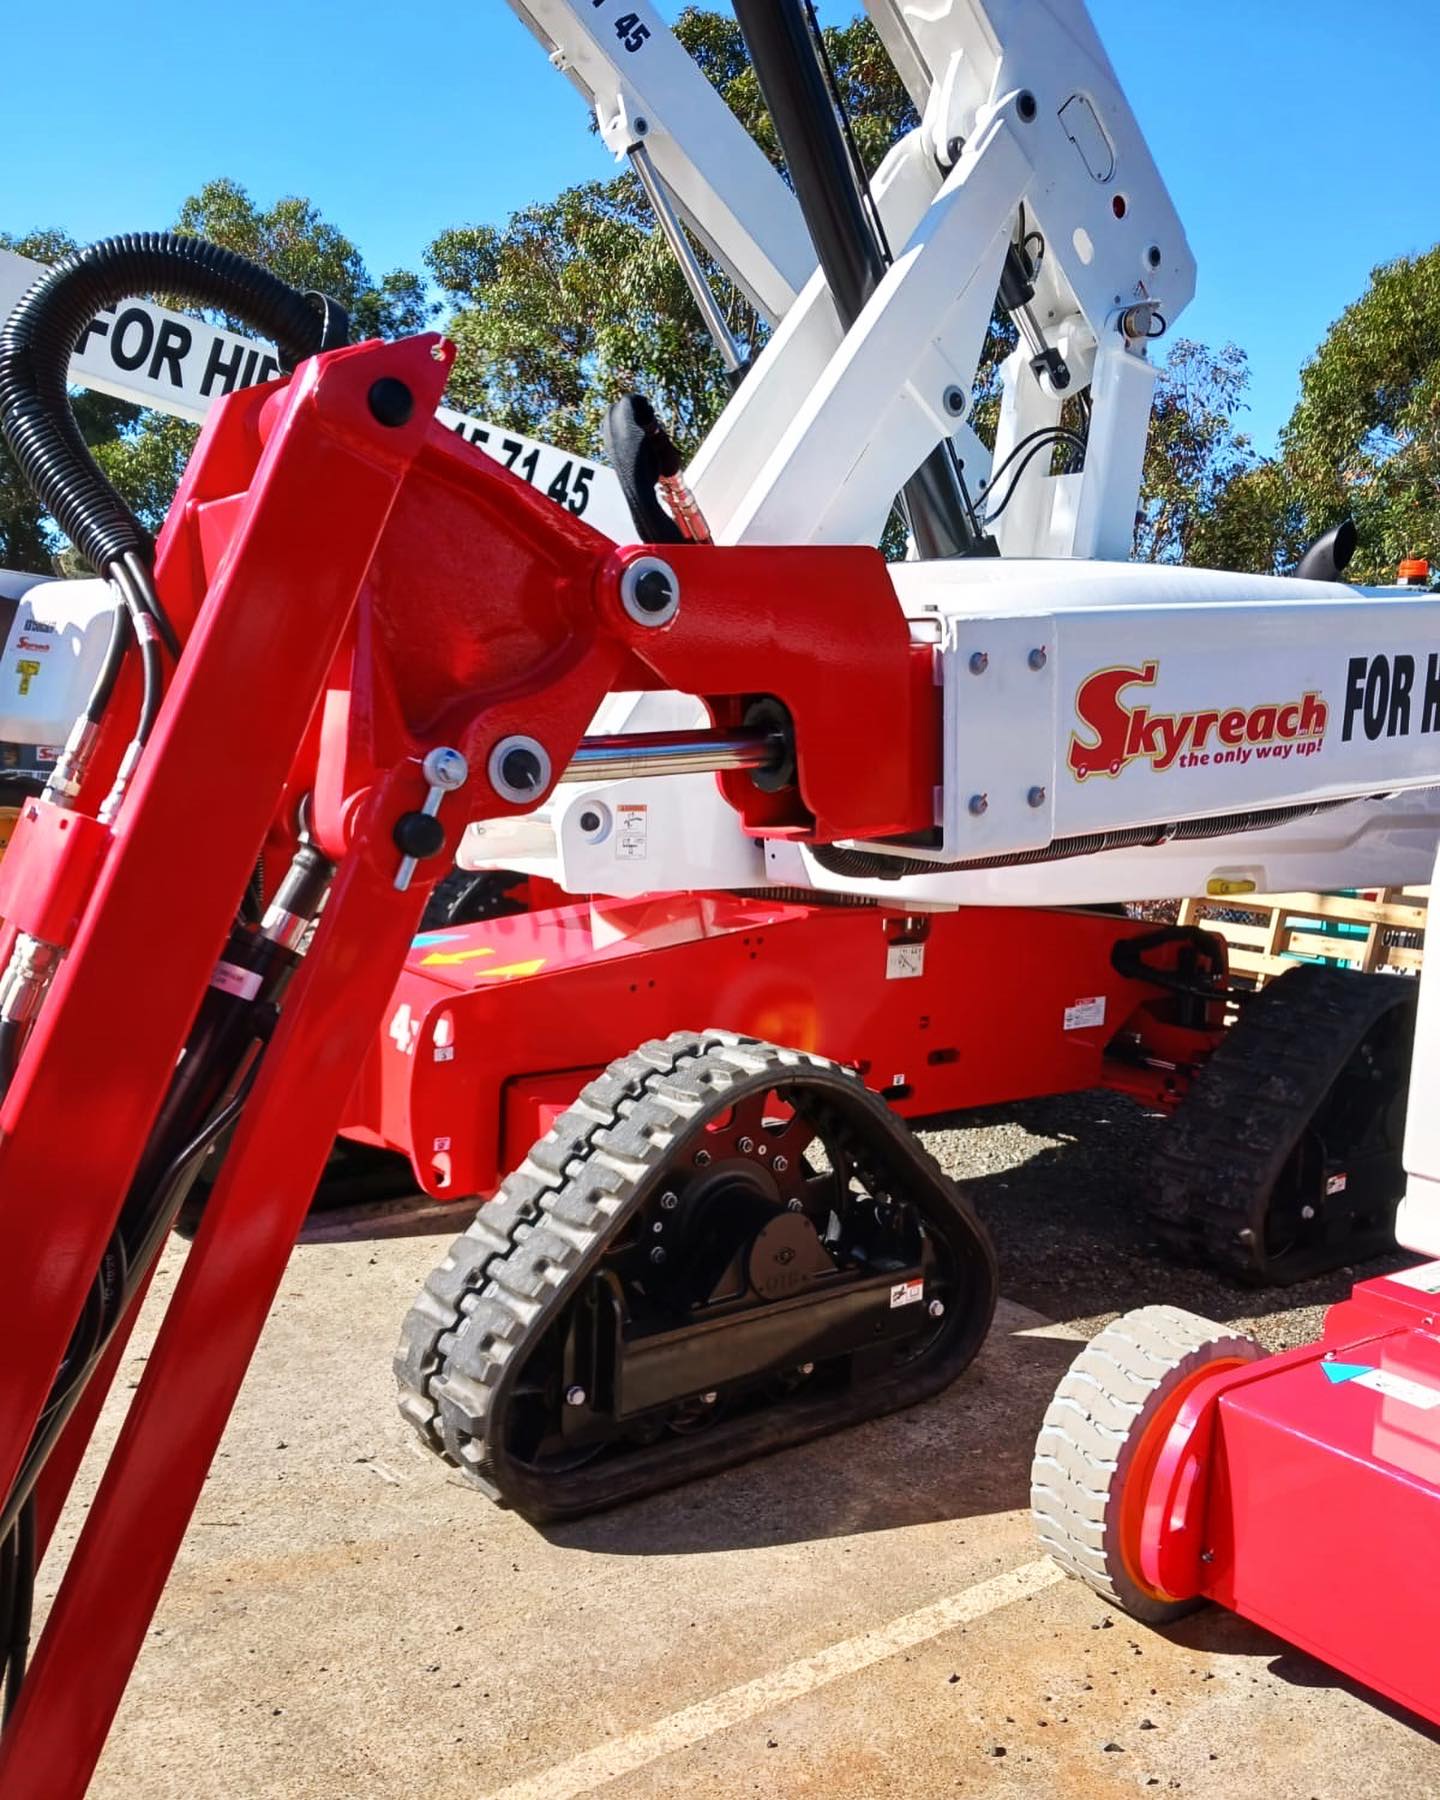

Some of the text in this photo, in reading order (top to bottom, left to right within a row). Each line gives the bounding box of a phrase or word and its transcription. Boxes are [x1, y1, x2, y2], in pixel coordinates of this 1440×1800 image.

[614, 13, 651, 53] 45
[547, 460, 595, 517] 45
[1068, 661, 1328, 782] Skyreach
[1342, 653, 1416, 742] FOR
[1179, 737, 1323, 768] the only way up!
